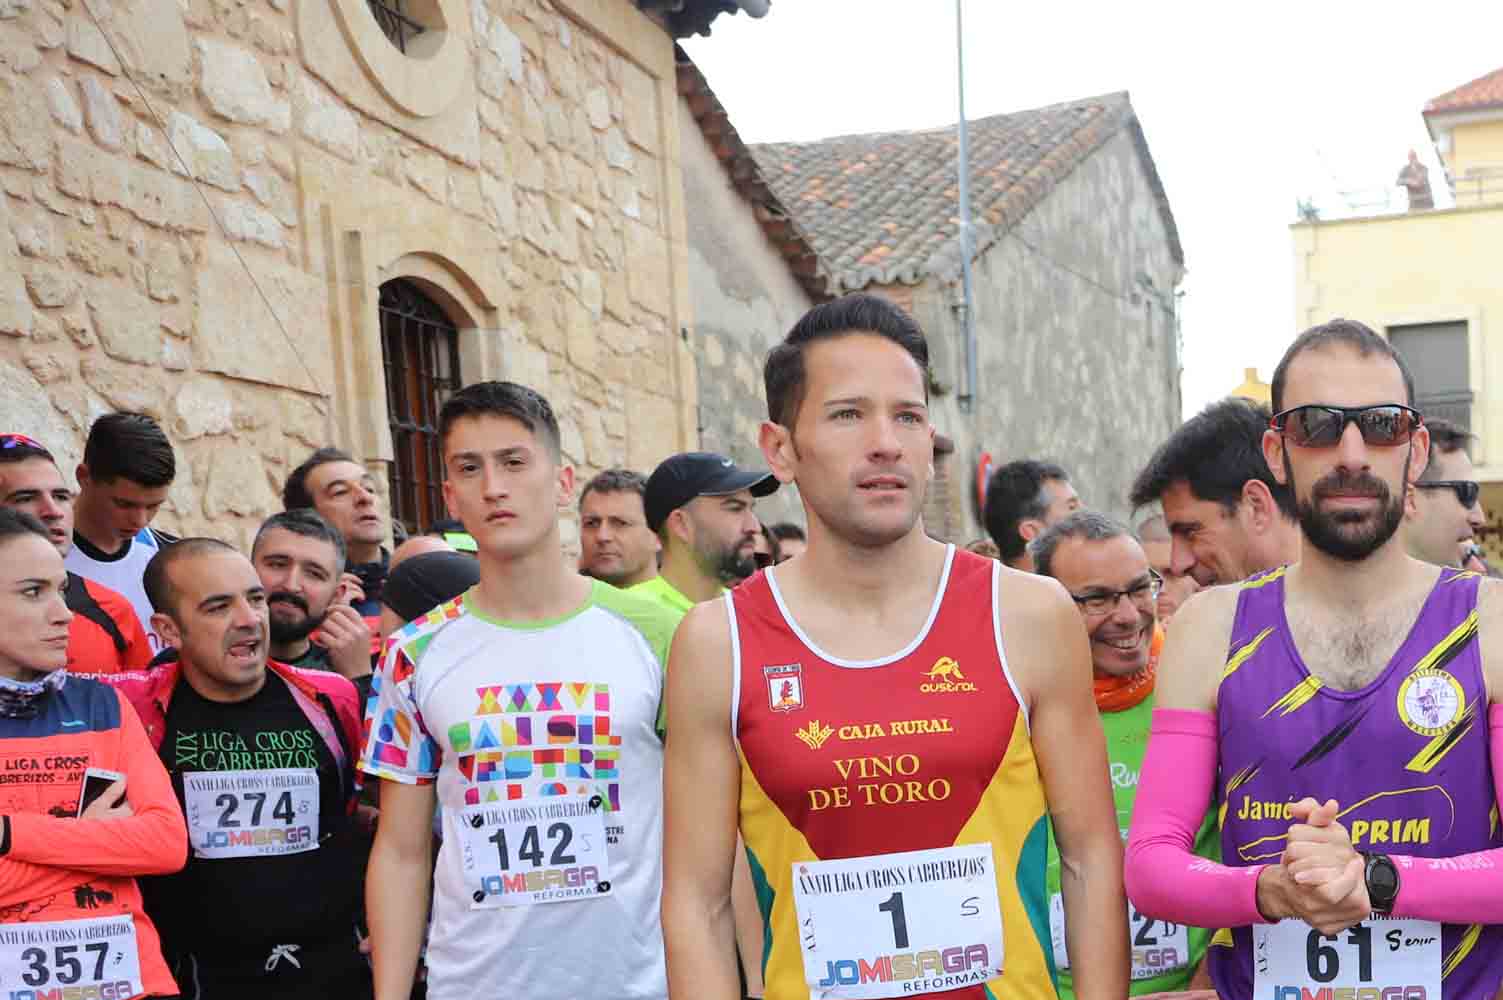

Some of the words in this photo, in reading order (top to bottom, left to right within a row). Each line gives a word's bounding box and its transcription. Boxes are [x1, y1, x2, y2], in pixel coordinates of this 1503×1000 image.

[203, 732, 249, 751] LIGA
[256, 730, 314, 751] CROSS
[838, 724, 886, 740] CAJA
[890, 718, 953, 737] RURAL
[5, 757, 39, 770] LIGA
[201, 750, 320, 771] CABRERIZOS
[832, 754, 920, 781] VINO
[808, 786, 851, 811] DE
[858, 778, 951, 806] TORO
[1239, 796, 1295, 820] Jamó
[215, 792, 297, 828] 274
[1352, 818, 1431, 845] PRIM
[488, 822, 576, 871] 142
[834, 870, 864, 894] LIGA
[866, 866, 906, 890] CROSS
[908, 856, 988, 883] CABRERIZOS
[959, 896, 981, 917] S
[878, 892, 909, 949] 1
[21, 942, 109, 987] 357
[819, 944, 989, 987] JOMISAGA
[1306, 923, 1372, 983] 61
[903, 969, 988, 993] REFORMAS
